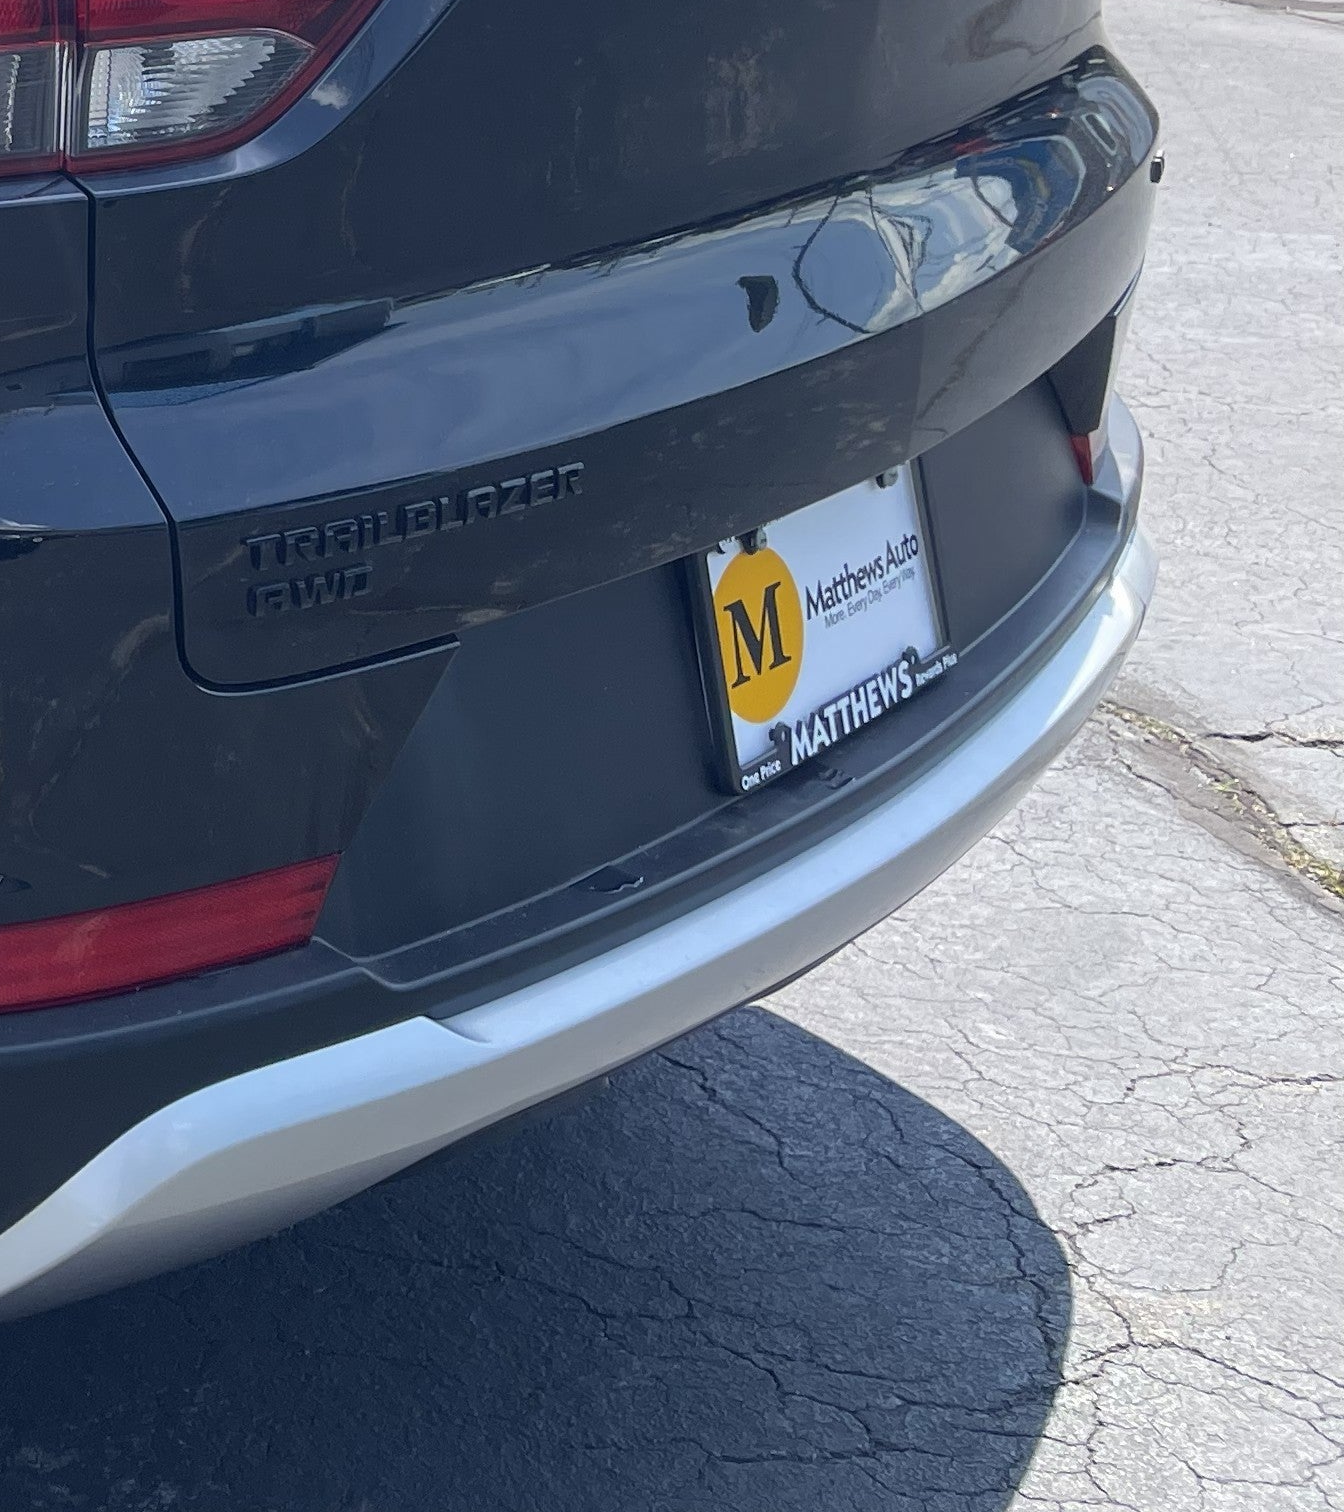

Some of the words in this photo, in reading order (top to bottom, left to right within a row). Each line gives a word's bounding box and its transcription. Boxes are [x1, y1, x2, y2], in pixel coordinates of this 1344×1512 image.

[246, 461, 585, 571] TRAILBLAZER
[247, 565, 373, 618] AWD
[723, 580, 792, 690] M
[805, 554, 885, 621] Matthews
[886, 533, 919, 575] Auto
[847, 598, 868, 619] Every
[791, 659, 912, 766] MATTHEWS
[741, 771, 760, 791] One
[760, 759, 782, 780] Price
